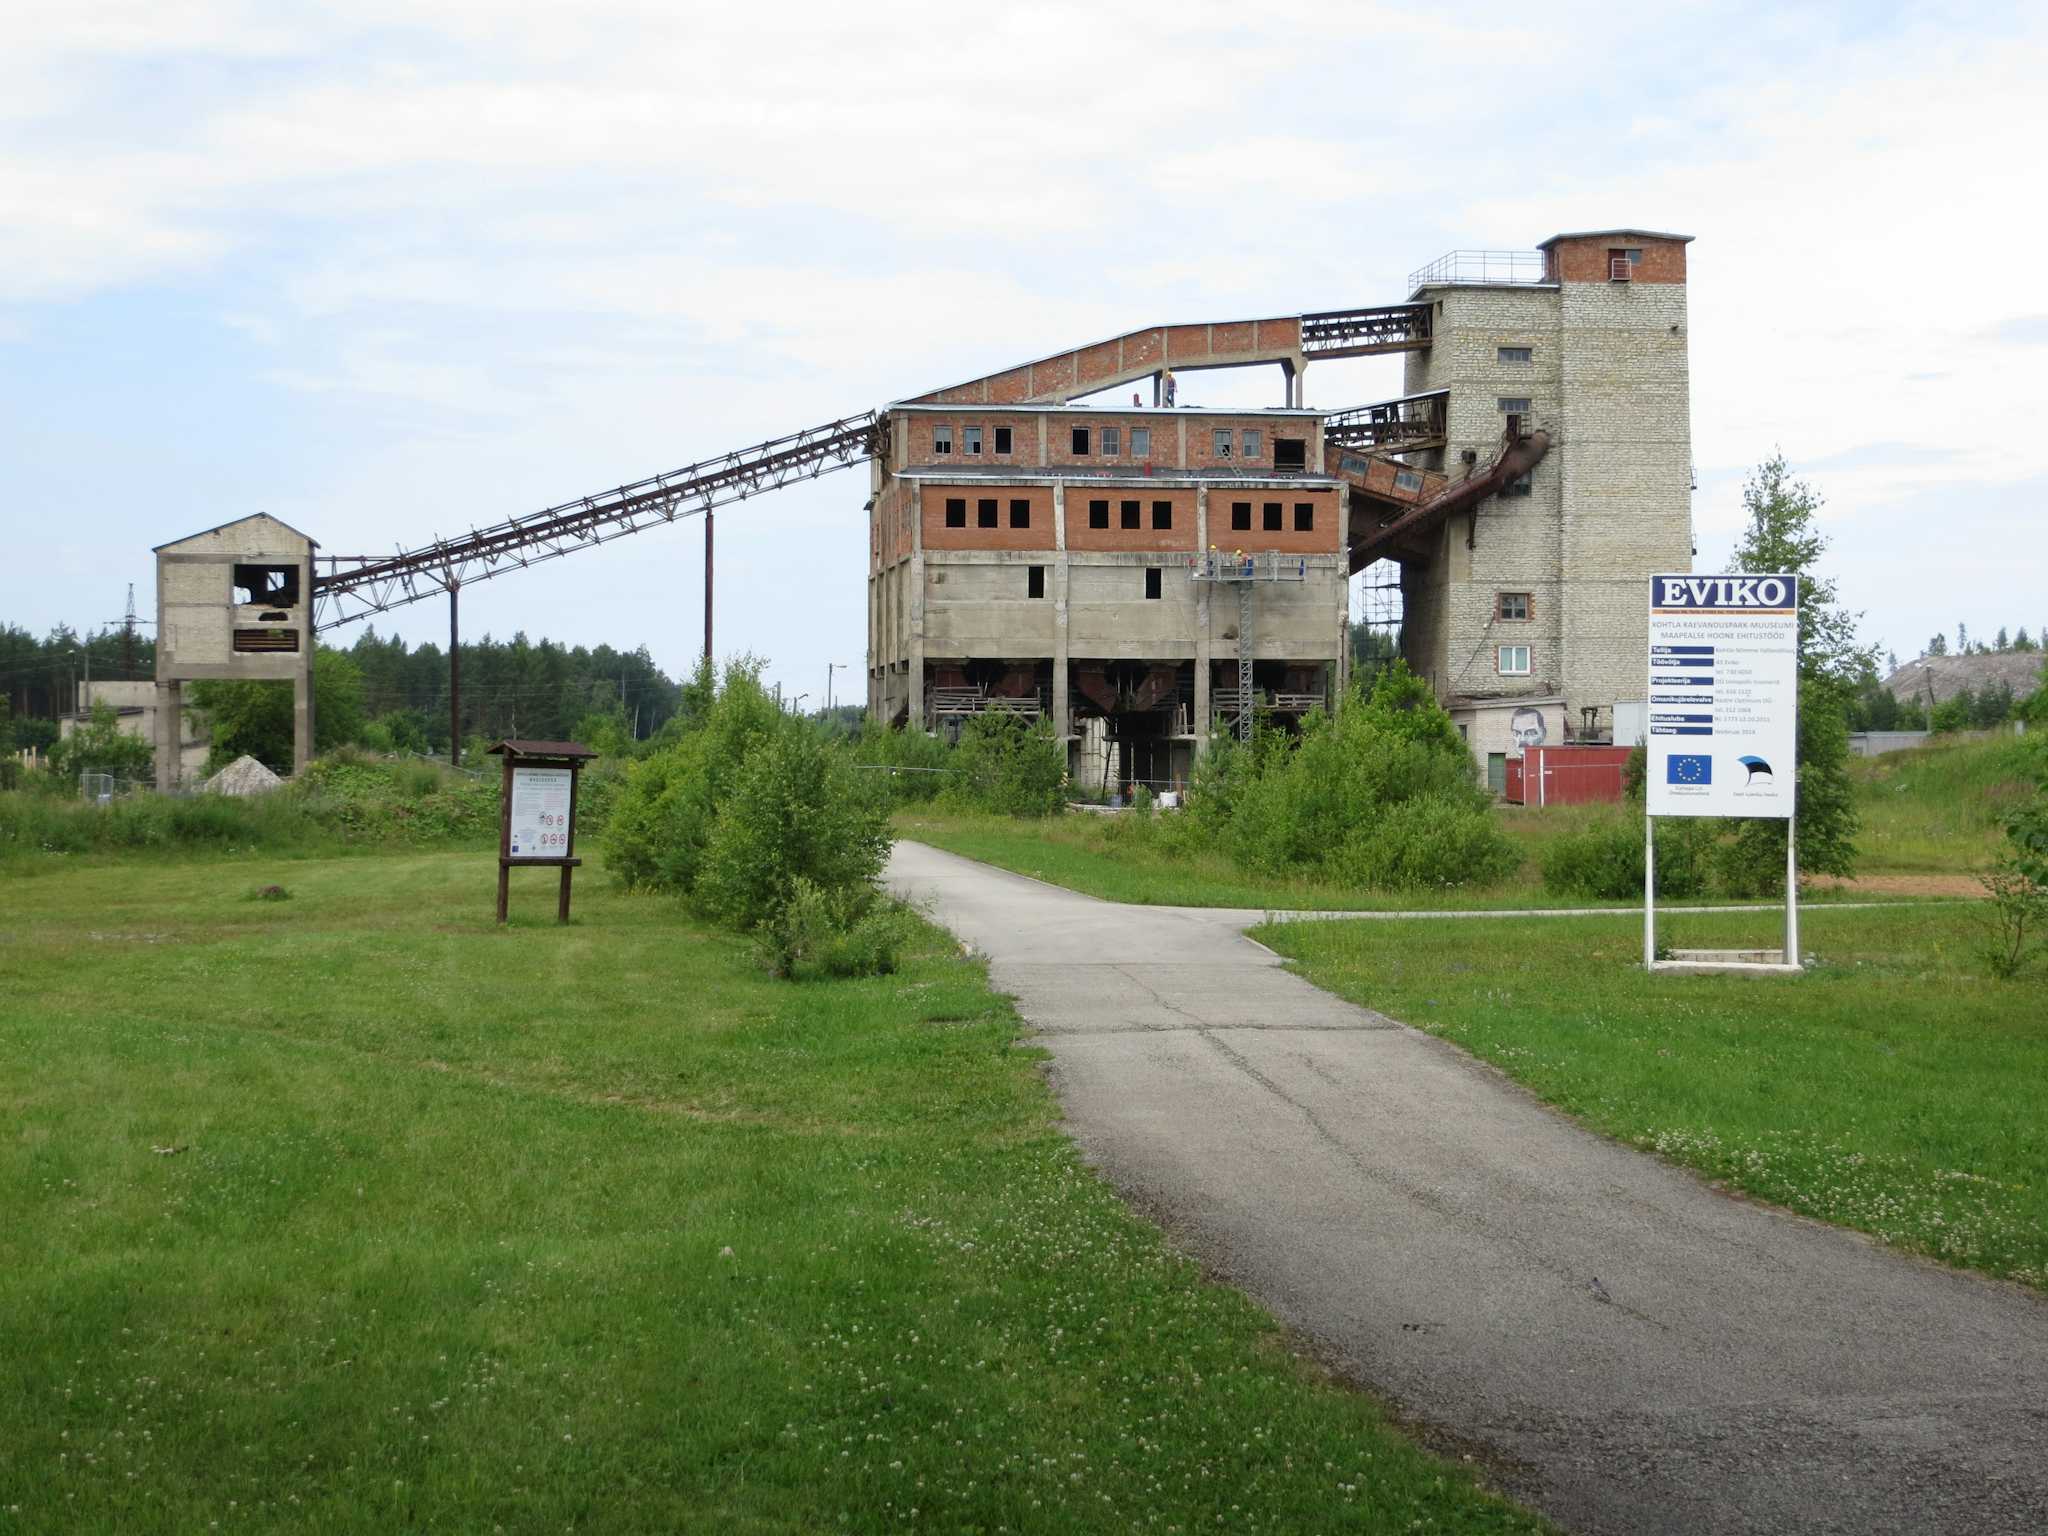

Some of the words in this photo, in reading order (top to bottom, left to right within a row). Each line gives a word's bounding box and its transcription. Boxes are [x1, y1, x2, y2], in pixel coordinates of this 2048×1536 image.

[1661, 578, 1786, 606] EVIKO
[1652, 621, 1681, 629] KOHTLA
[1660, 631, 1705, 640] MAAPEALSE
[1707, 631, 1734, 640] HOONE
